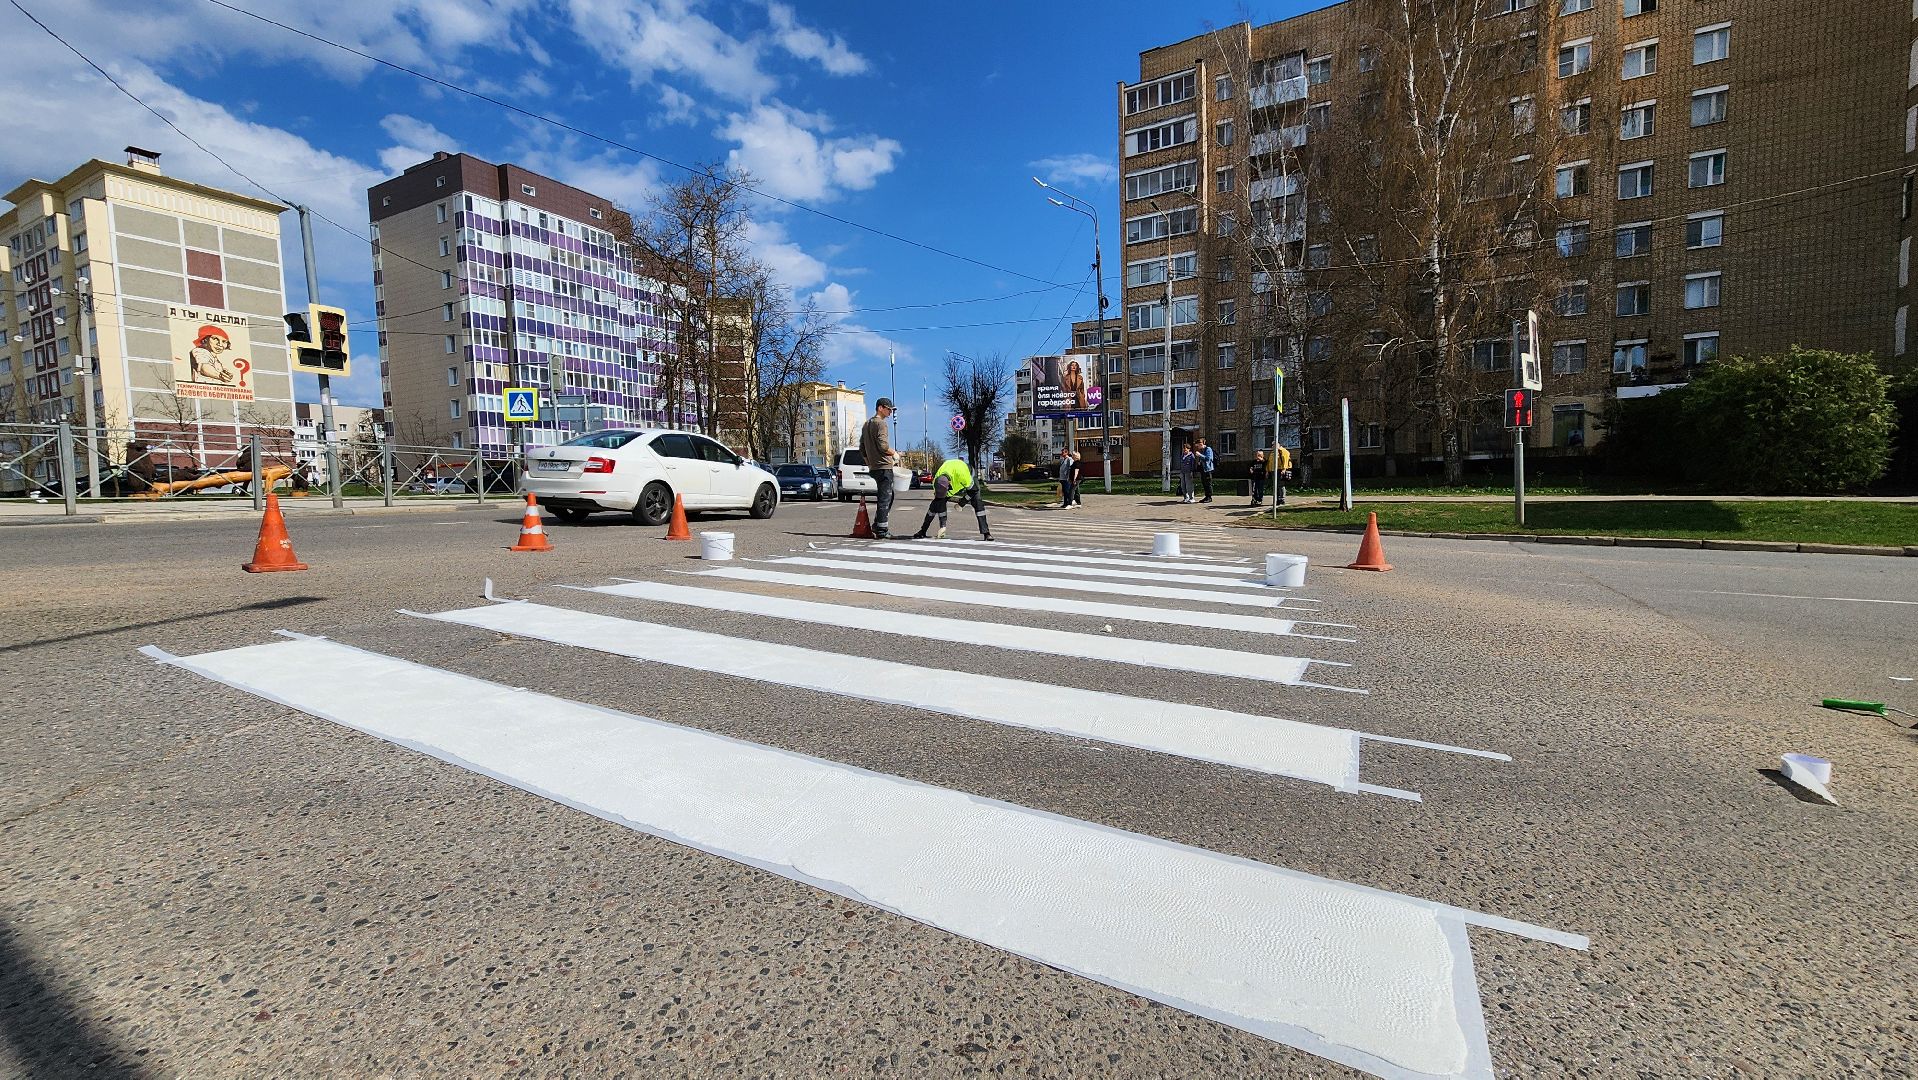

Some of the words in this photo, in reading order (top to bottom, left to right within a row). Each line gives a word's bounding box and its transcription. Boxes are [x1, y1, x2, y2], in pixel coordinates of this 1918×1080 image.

[170, 308, 176, 316] А
[181, 309, 198, 319] ТЫ
[206, 313, 246, 326] СДЕЛАЛ
[177, 389, 207, 397] ГАЗОВОГО
[1038, 399, 1076, 407] гардероба
